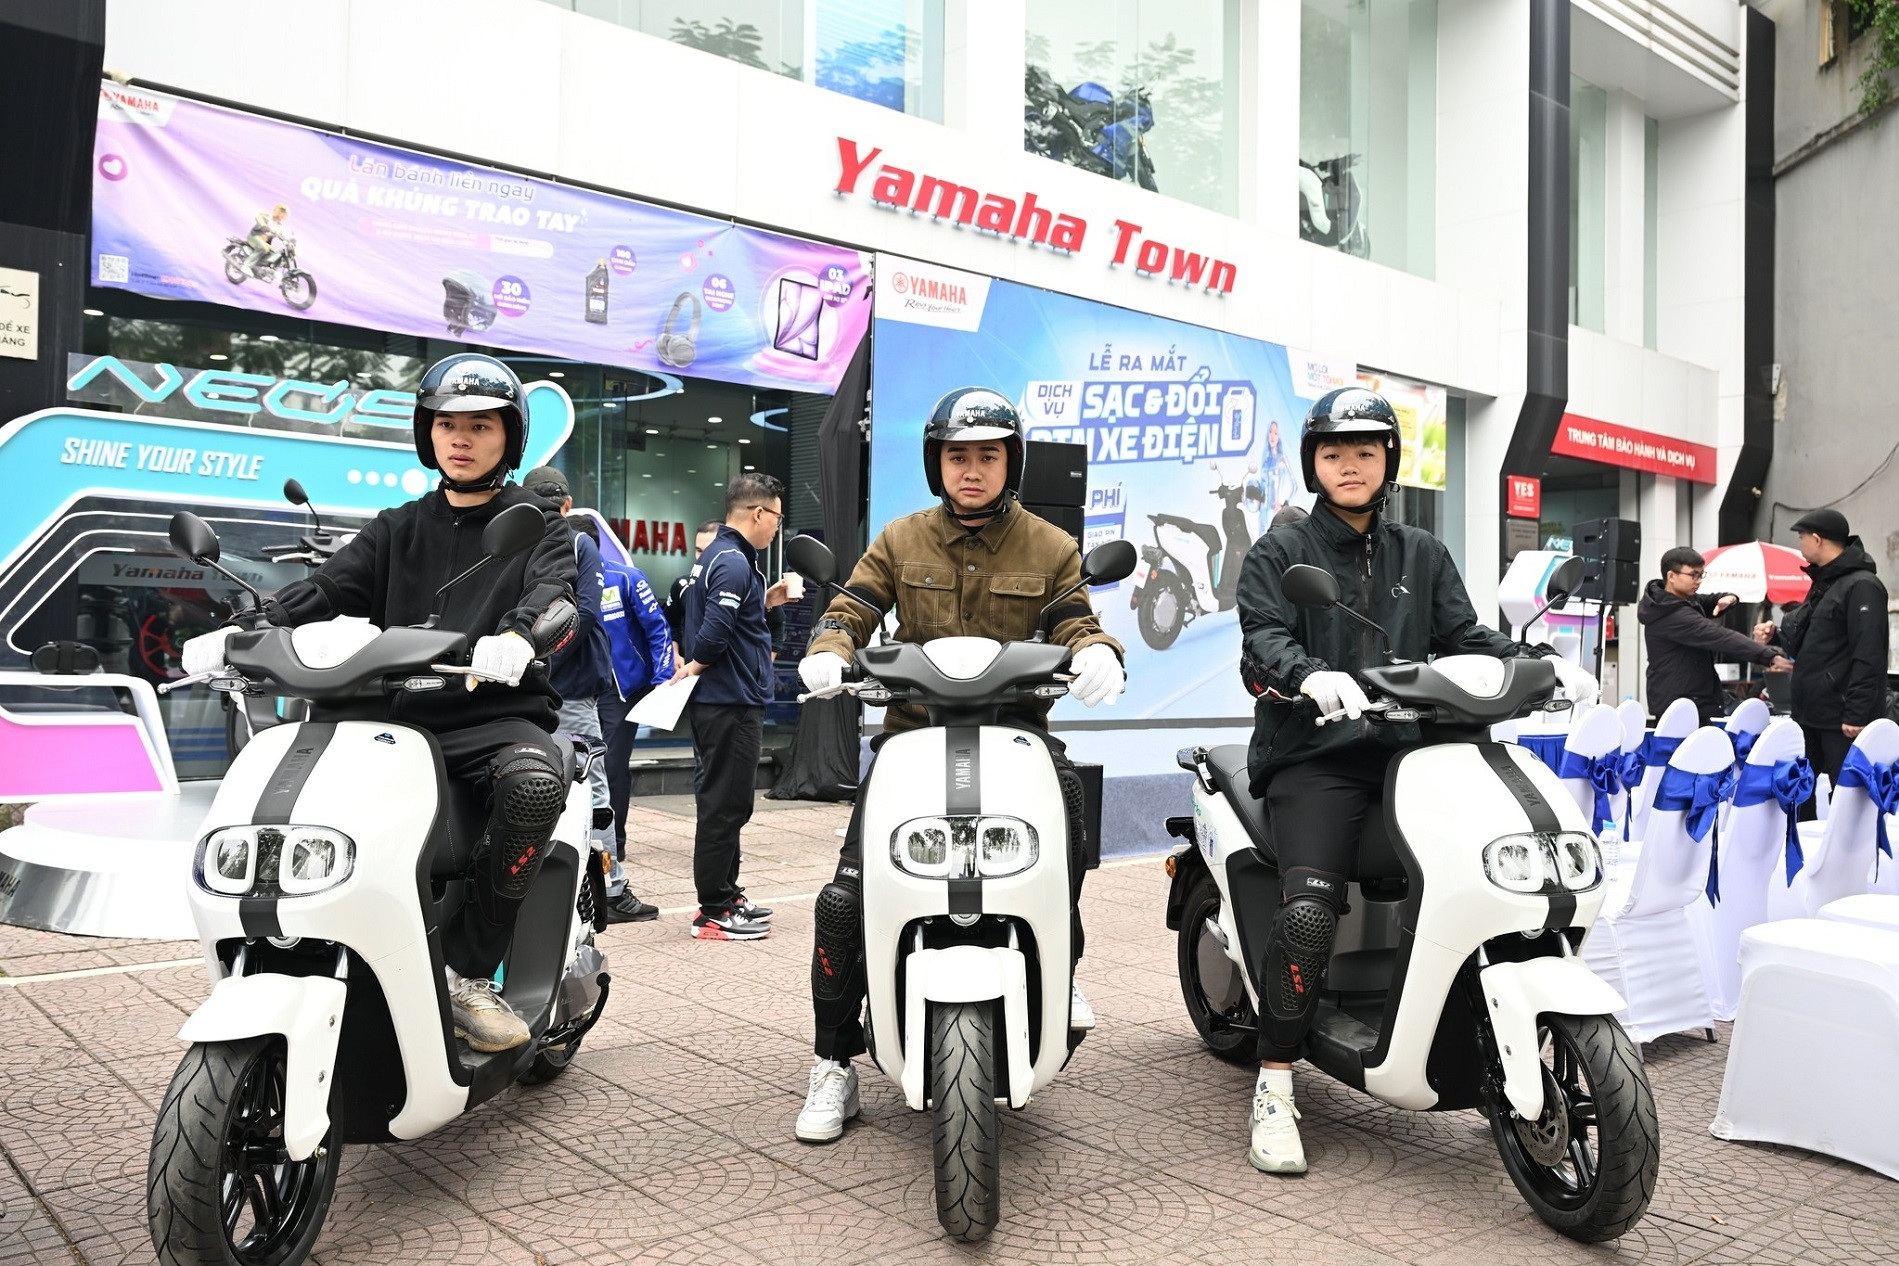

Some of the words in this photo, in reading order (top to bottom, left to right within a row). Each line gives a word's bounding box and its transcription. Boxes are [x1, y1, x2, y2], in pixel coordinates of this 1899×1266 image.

[113, 92, 159, 112] YAMAHA
[393, 160, 444, 186] bánh
[449, 171, 483, 193] liền
[488, 181, 536, 202] ngay
[365, 186, 458, 217] KHỦNG
[465, 199, 531, 227] TRAO
[536, 209, 582, 234] TAY
[836, 136, 1087, 253] Yamaha
[1115, 219, 1237, 294] Town
[828, 267, 845, 281] 03
[501, 280, 523, 297] 30
[910, 275, 967, 306] YAMAHA
[0, 334, 26, 347] ÀNG
[16, 324, 31, 335] XE
[1088, 343, 1113, 371] LỄ
[1118, 354, 1143, 371] RA
[1150, 344, 1188, 371] MẮT
[1037, 384, 1073, 403] DỊCH
[1043, 401, 1065, 419] VỤ
[1096, 426, 1141, 462] XE
[1141, 416, 1220, 463] ĐIỆN
[1567, 427, 1596, 447] TRUNG
[1597, 432, 1616, 450] TÂM
[1615, 436, 1633, 454] BẢO
[1633, 440, 1656, 460] HÀNH
[1655, 445, 1668, 462] VÀ
[1667, 450, 1685, 467] DỊCH
[1685, 454, 1696, 471] VỤ
[60, 437, 133, 469] SHINE
[137, 444, 198, 475] YOUR
[198, 450, 265, 481] STYLE
[1091, 481, 1123, 508] PHÍ
[1514, 481, 1535, 498] YES
[610, 518, 688, 553] MAHA
[1087, 531, 1103, 539] GIAO
[112, 563, 204, 581] Yamaha
[955, 748, 971, 790] YAMAHA
[510, 846, 536, 875] LS2
[818, 947, 834, 976] LS2
[1289, 964, 1305, 994] LS2
